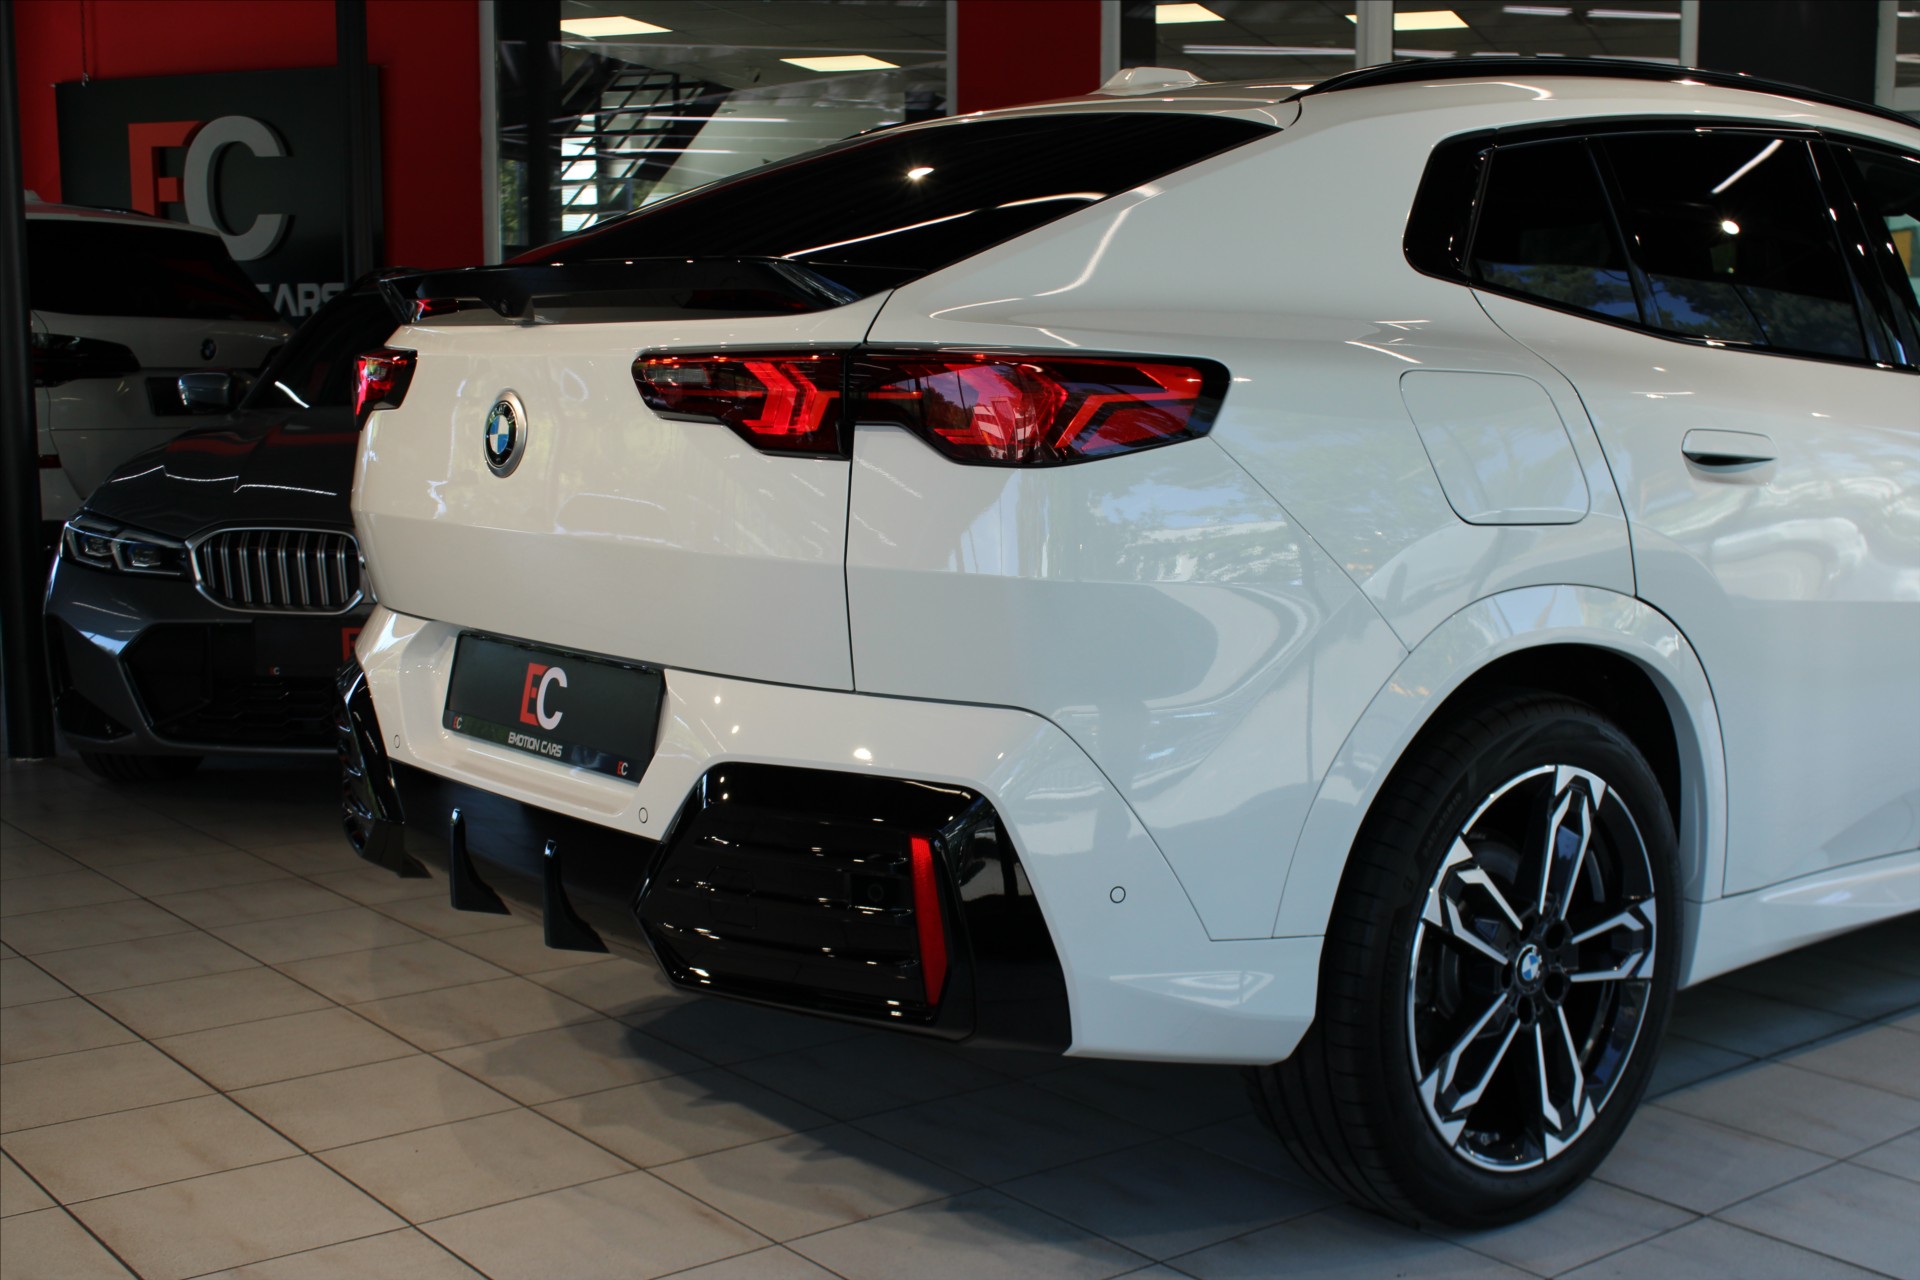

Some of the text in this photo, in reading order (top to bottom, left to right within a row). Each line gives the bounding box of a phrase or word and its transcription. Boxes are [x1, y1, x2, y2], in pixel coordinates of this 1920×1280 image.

[519, 662, 568, 730] EC
[453, 716, 462, 729] EC
[508, 731, 563, 758] EMOTION CARS
[617, 761, 628, 776] EC
